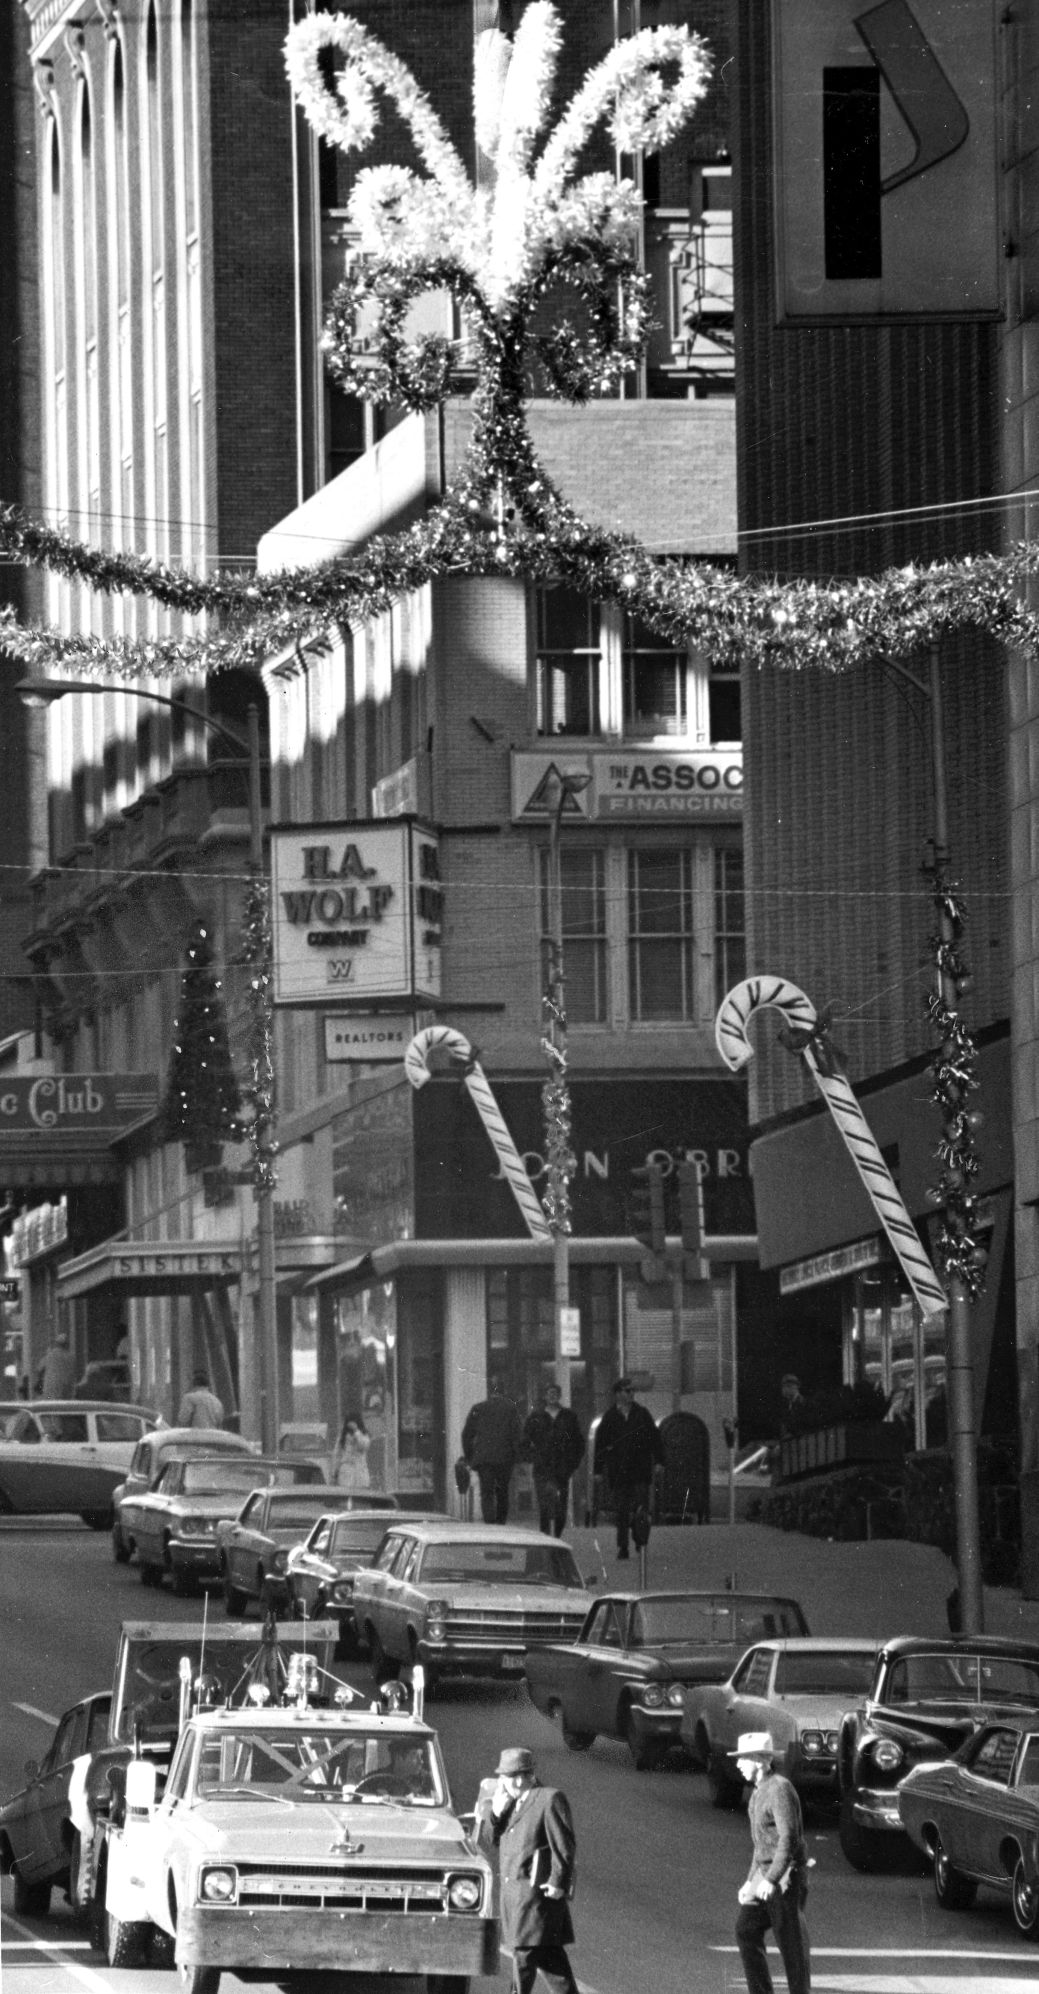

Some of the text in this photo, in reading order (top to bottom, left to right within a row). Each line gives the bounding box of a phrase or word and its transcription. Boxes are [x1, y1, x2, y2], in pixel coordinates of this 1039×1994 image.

[609, 765, 743, 790] THE ASSOC
[610, 797, 743, 811] FINANCING
[301, 843, 377, 880] H.A.
[280, 885, 393, 925] WOLF
[327, 959, 352, 978] W
[335, 1032, 403, 1043] REALTORS
[28, 1078, 104, 1128] Club
[490, 1150, 609, 1181] ON
